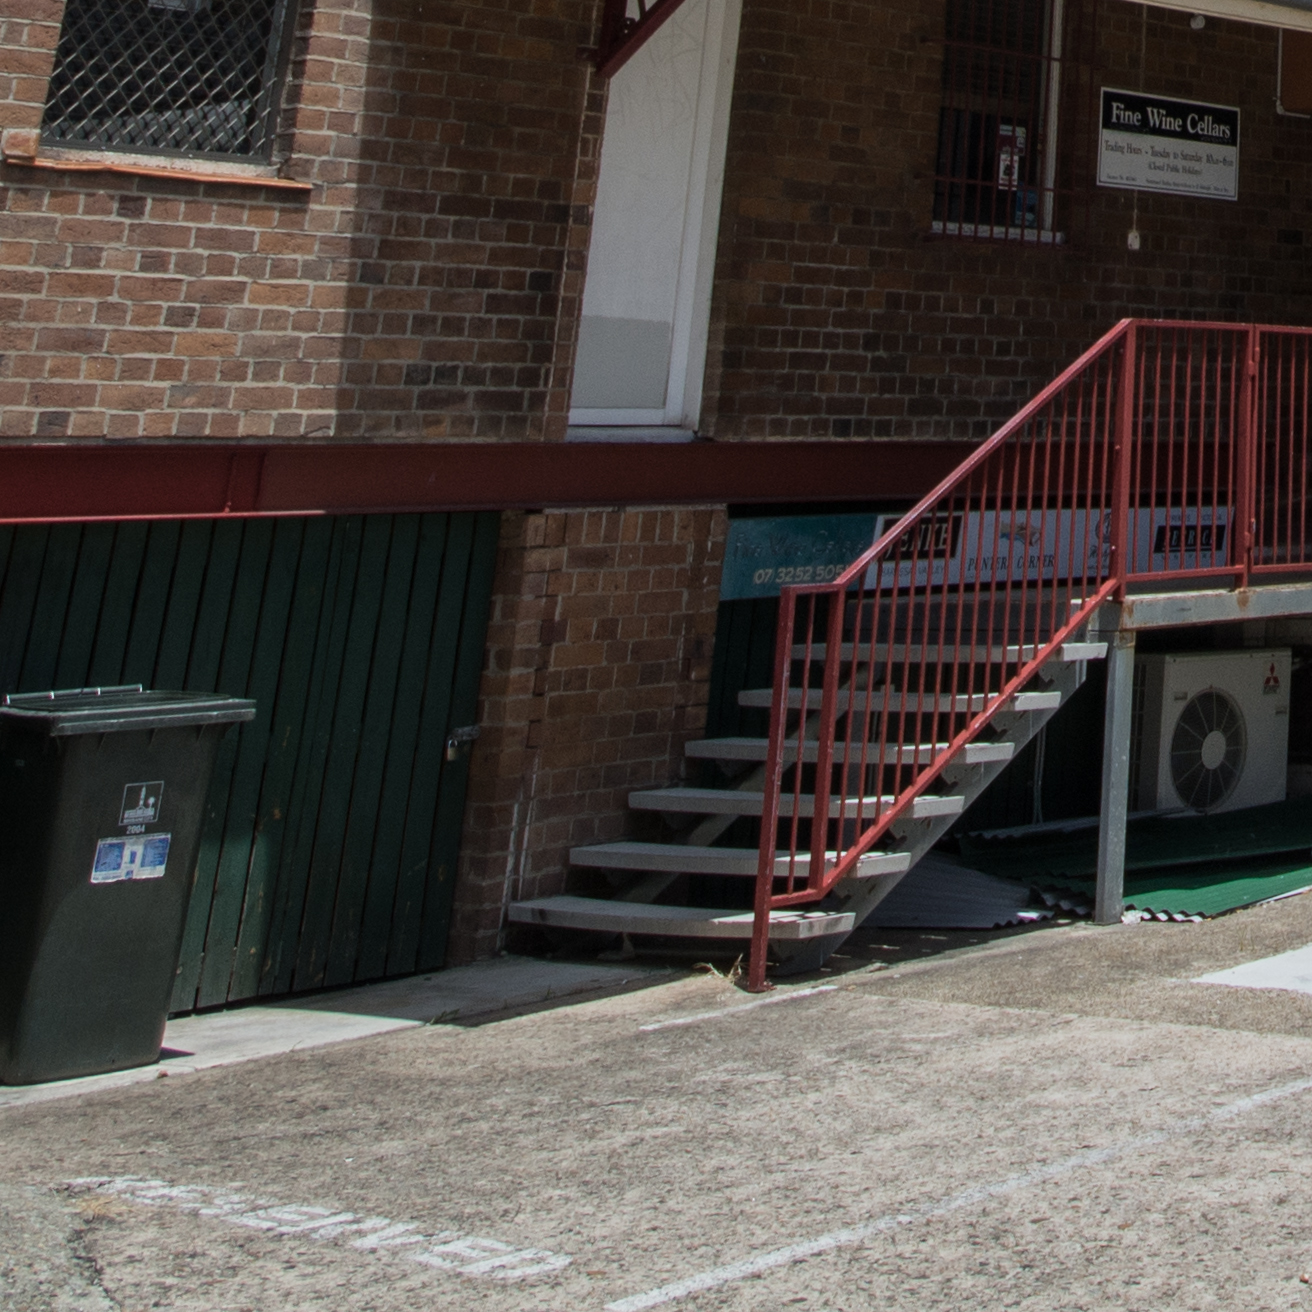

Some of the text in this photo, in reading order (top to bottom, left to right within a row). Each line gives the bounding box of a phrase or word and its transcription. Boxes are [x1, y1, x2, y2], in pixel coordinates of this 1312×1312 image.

[1110, 101, 1231, 139] Fine Wine Cellars
[775, 566, 813, 583] 3252
[815, 563, 849, 581] 505
[125, 824, 147, 835] 2004
